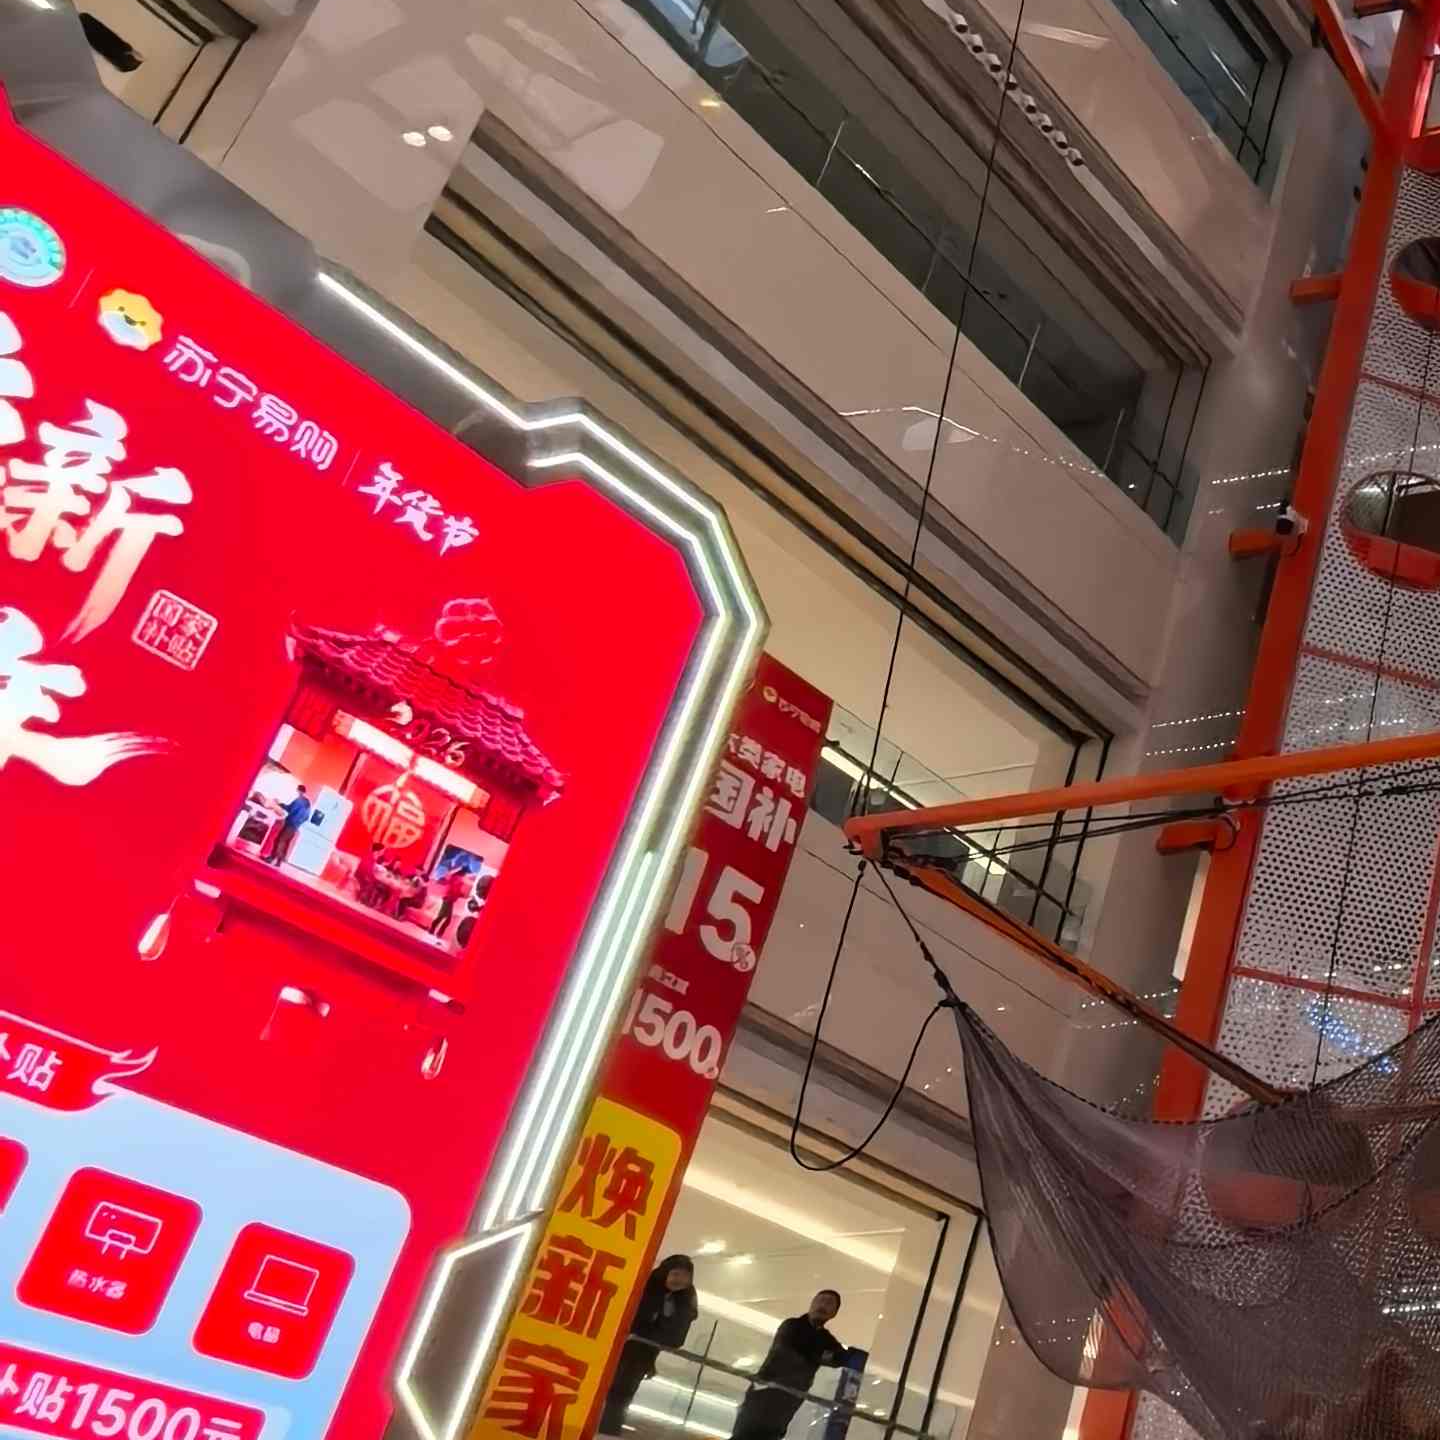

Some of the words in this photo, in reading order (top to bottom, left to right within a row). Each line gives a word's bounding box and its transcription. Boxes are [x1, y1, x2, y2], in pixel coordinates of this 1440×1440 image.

[163, 335, 340, 472] 苏宁易购
[357, 461, 481, 555] 年货节
[361, 772, 427, 849] 福
[704, 758, 798, 853] 国补
